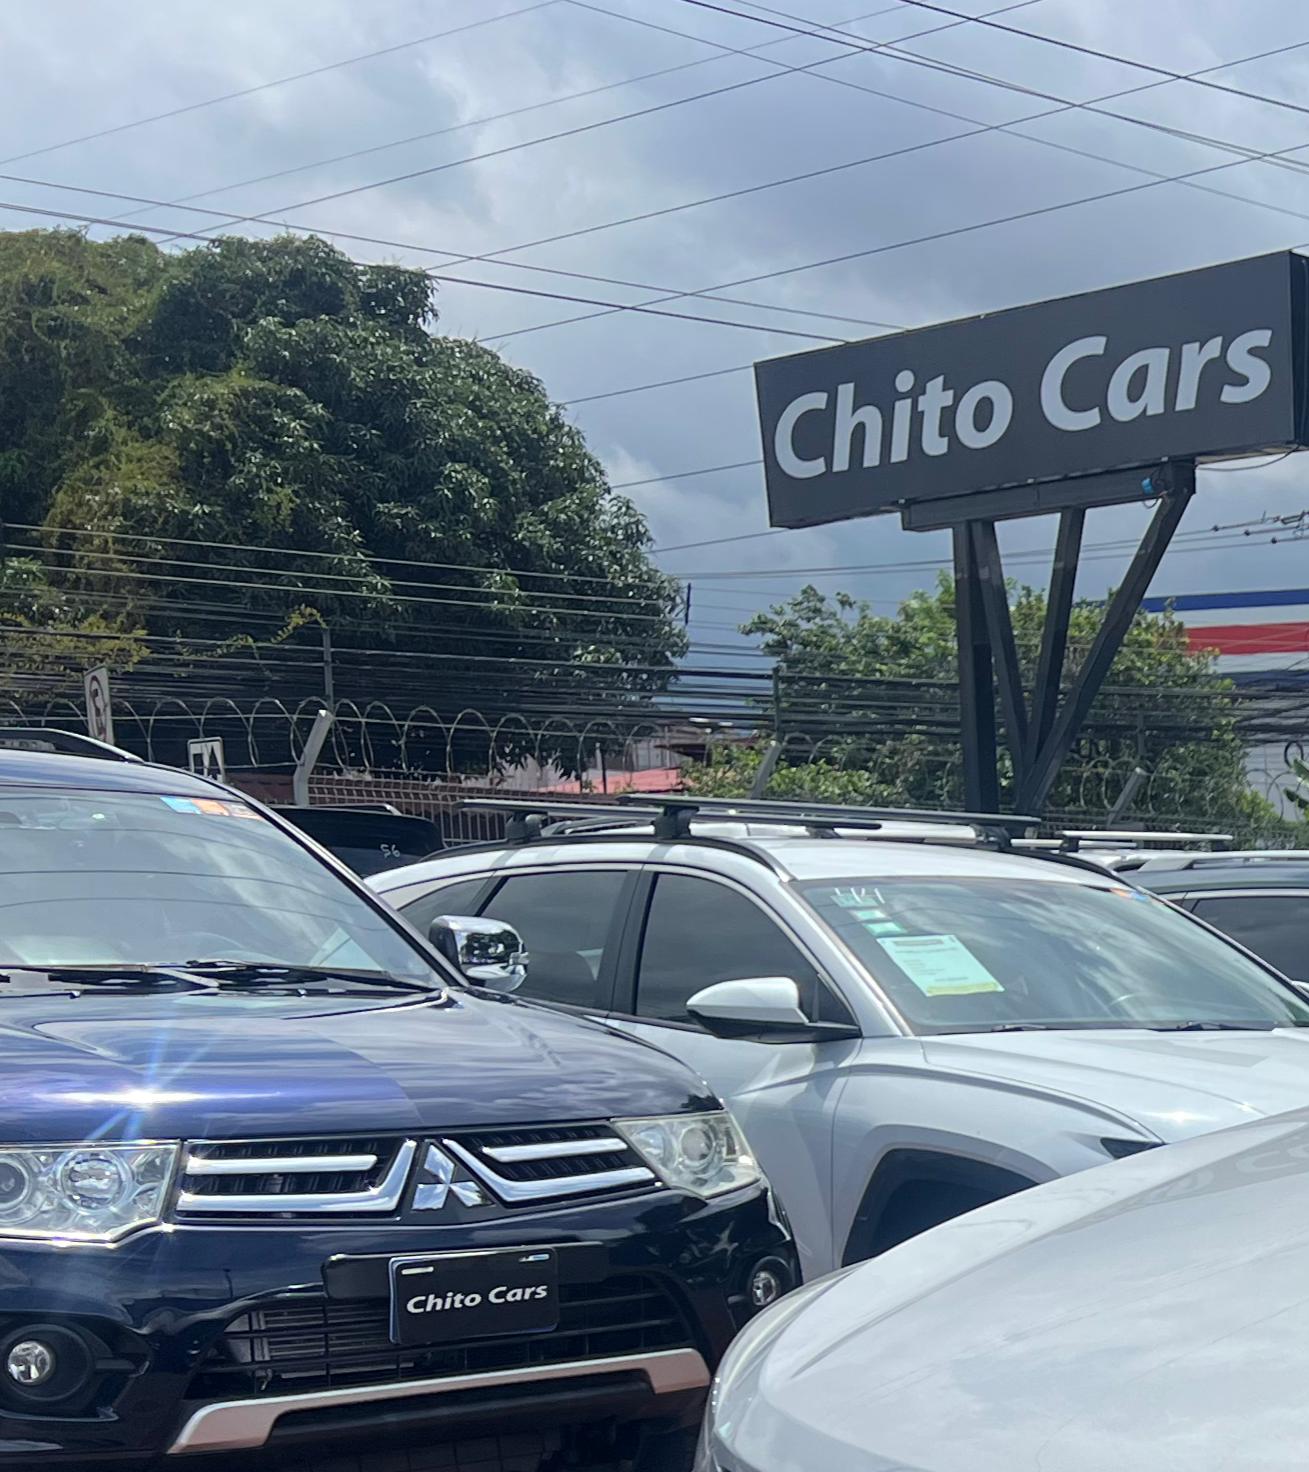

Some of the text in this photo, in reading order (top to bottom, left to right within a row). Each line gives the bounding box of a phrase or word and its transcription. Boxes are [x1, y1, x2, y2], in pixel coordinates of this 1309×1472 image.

[774, 329, 1273, 479] Chito Cars
[406, 1284, 548, 1314] Chito Cars
